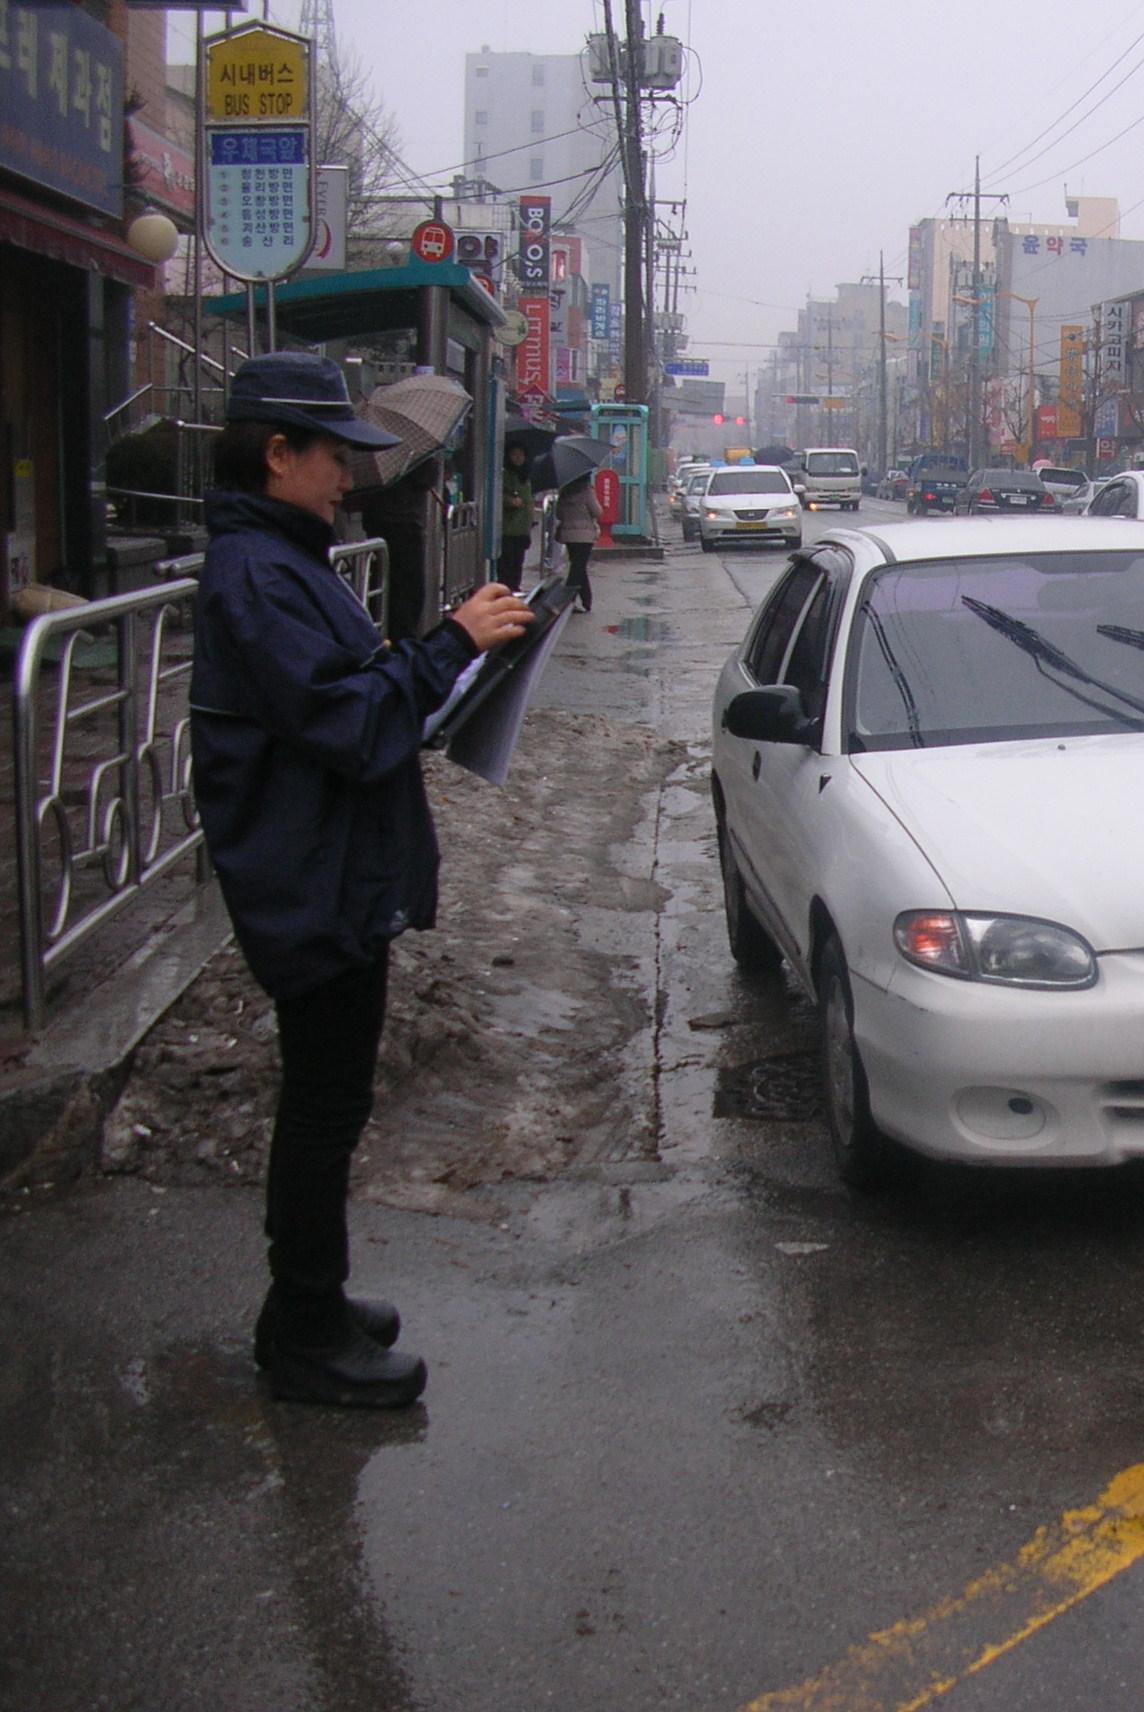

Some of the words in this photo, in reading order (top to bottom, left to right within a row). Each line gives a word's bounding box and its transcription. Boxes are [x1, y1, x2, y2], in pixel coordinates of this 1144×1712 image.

[220, 63, 294, 86] 시내버스
[224, 93, 250, 116] BUS
[258, 92, 293, 115] STOP
[1022, 235, 1088, 256] 윤약국
[1107, 306, 1124, 373] 시카고피자
